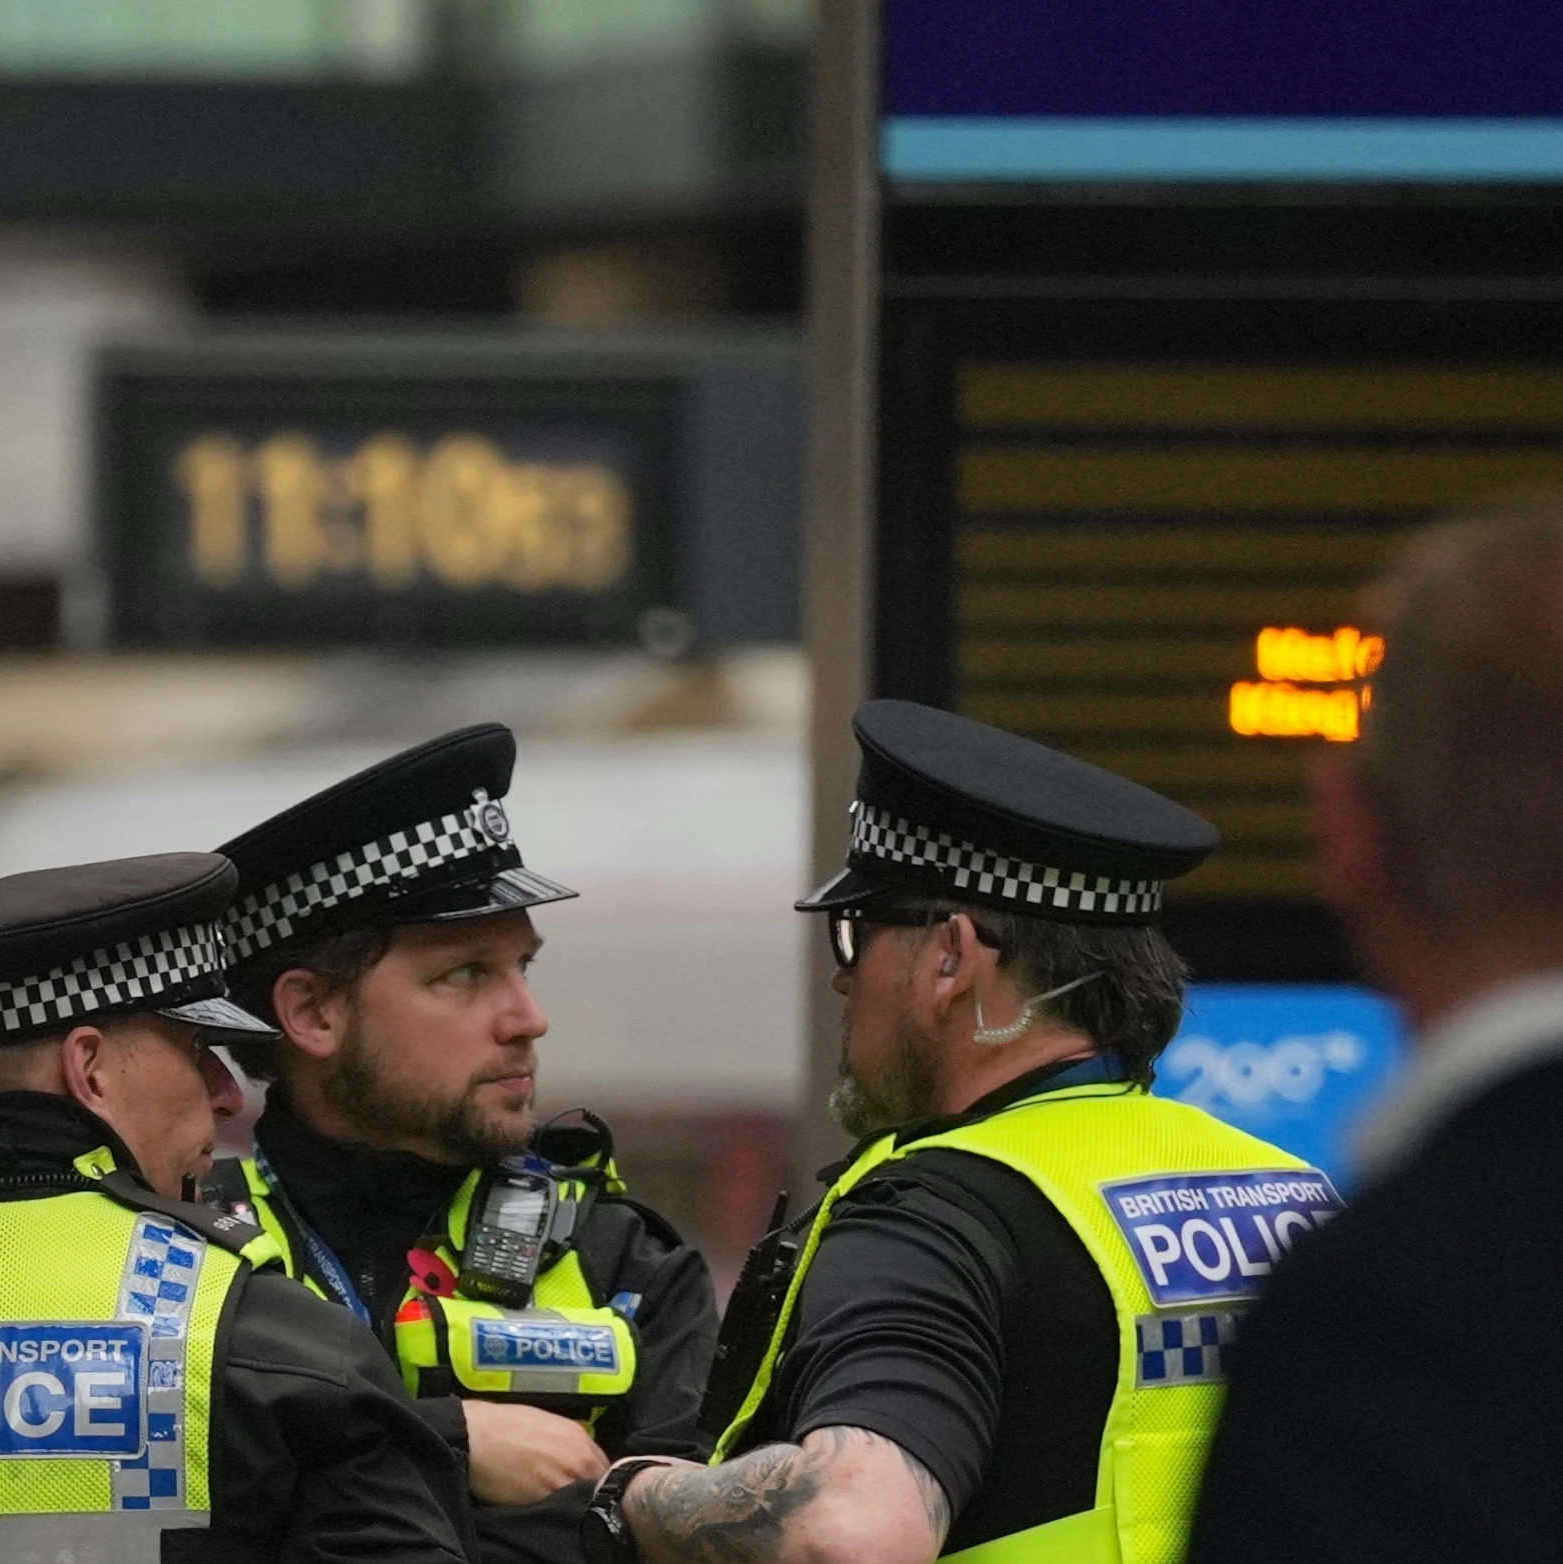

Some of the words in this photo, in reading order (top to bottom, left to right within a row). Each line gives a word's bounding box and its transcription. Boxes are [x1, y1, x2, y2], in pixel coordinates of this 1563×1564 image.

[1119, 1187, 1210, 1219] BRITISH
[1209, 1182, 1329, 1209] TRANSPORT
[1133, 1210, 1345, 1287] POLIC
[515, 1337, 611, 1363] POLICE
